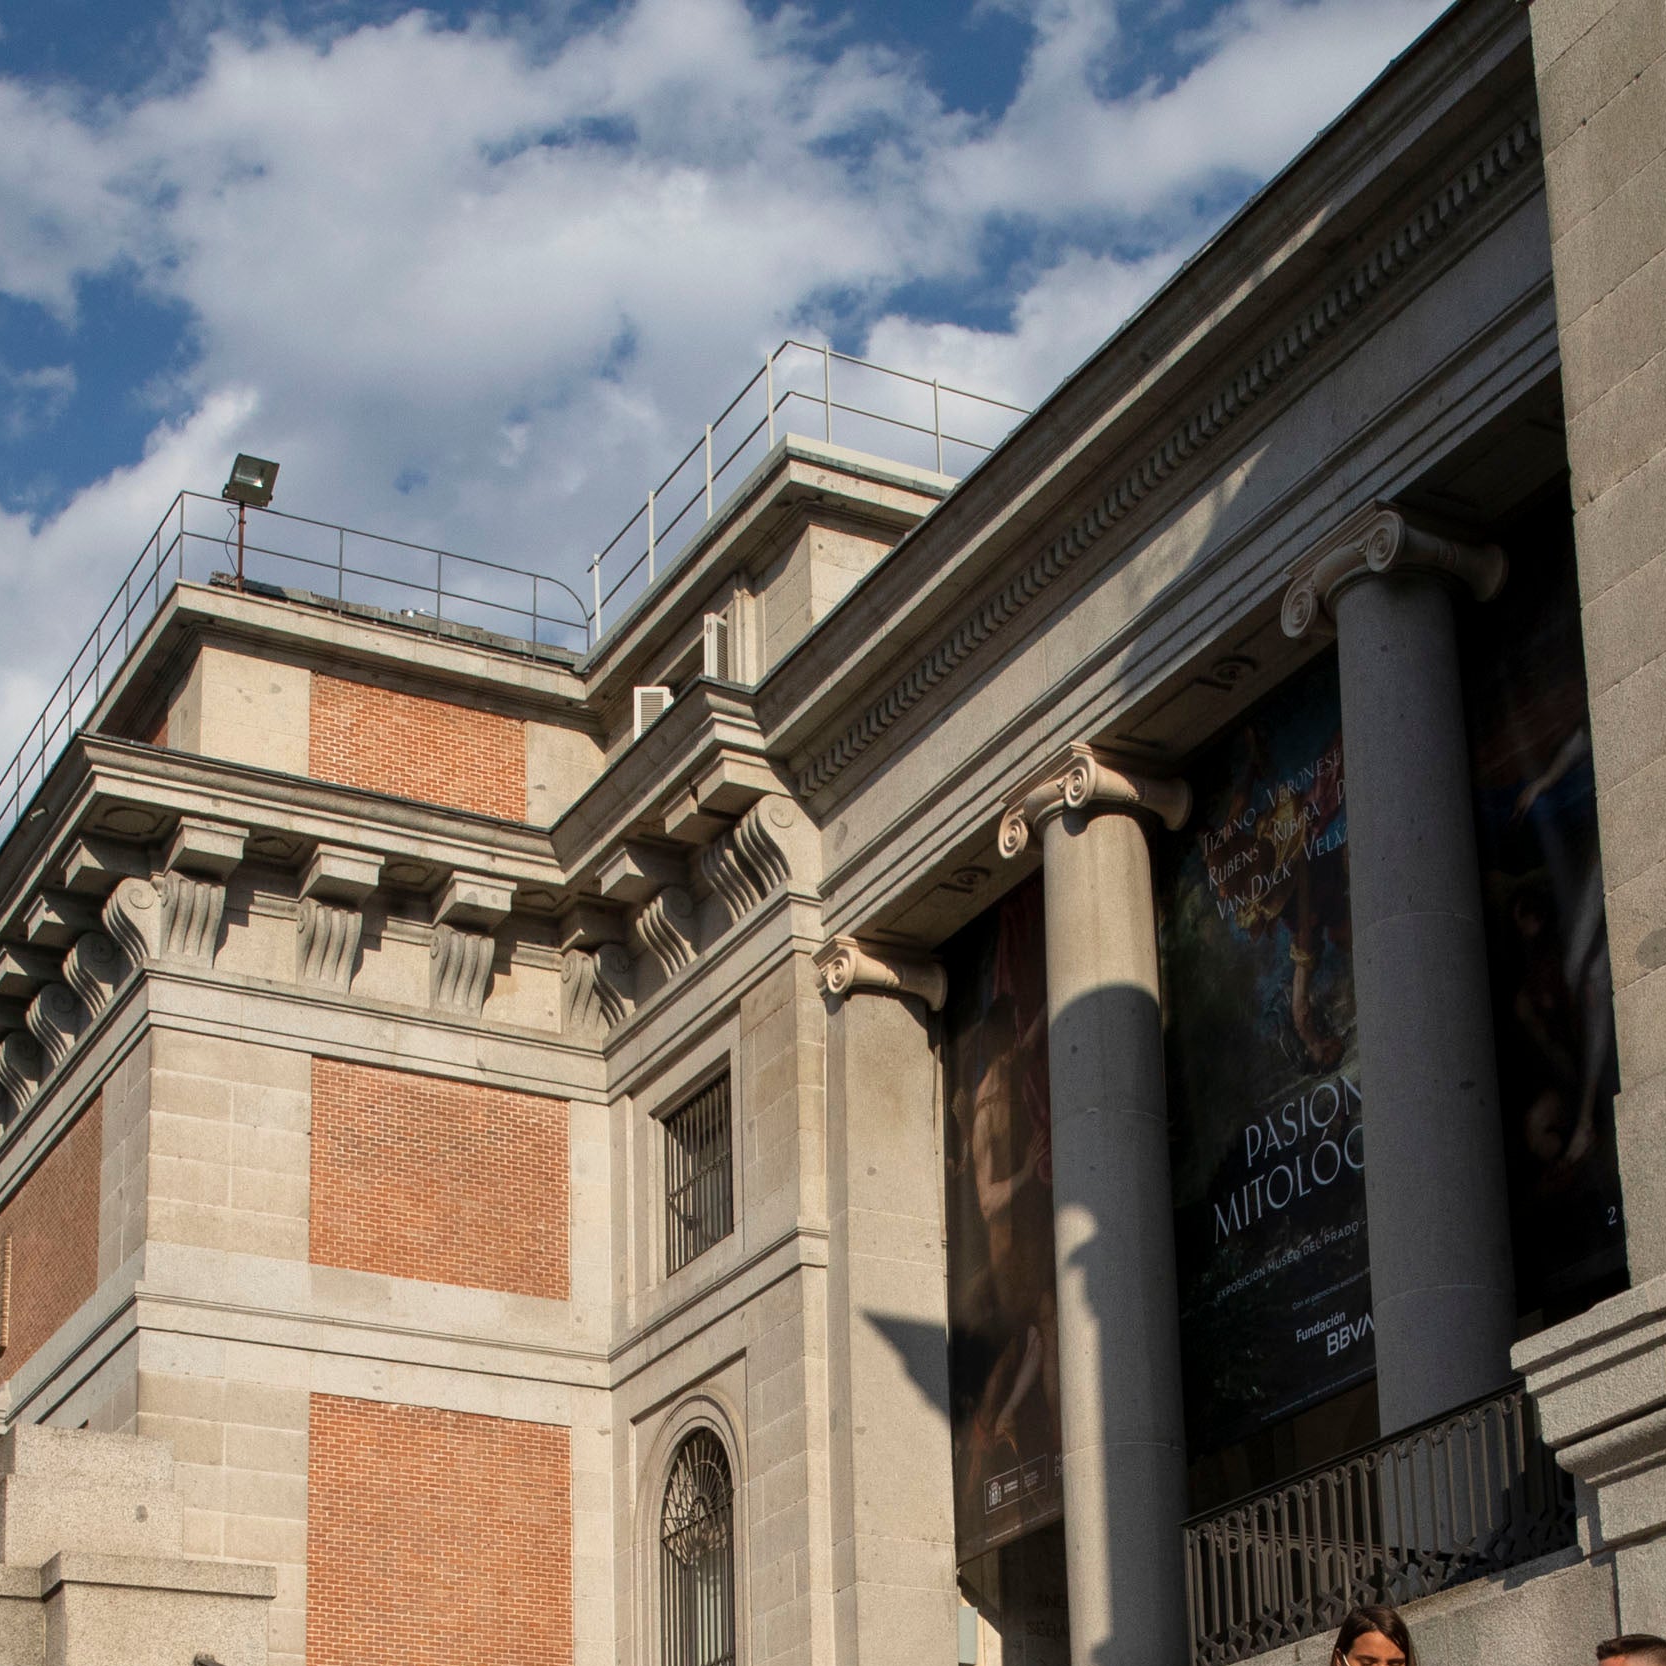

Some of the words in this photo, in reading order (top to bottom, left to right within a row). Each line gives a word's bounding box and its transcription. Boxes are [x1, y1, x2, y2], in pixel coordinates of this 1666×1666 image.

[1203, 808, 1256, 856] TIZIANO
[1267, 748, 1342, 808] VERONESE
[1208, 843, 1260, 891] RUBENS
[1217, 890, 1246, 921] VAN
[1251, 859, 1292, 901] DYCK
[1267, 1248, 1301, 1273] MUSEO
[1303, 1239, 1322, 1257] DEL
[1324, 1220, 1359, 1245] PRADO
[1296, 1311, 1346, 1344] Fundación
[1326, 1313, 1375, 1356] BBVA
